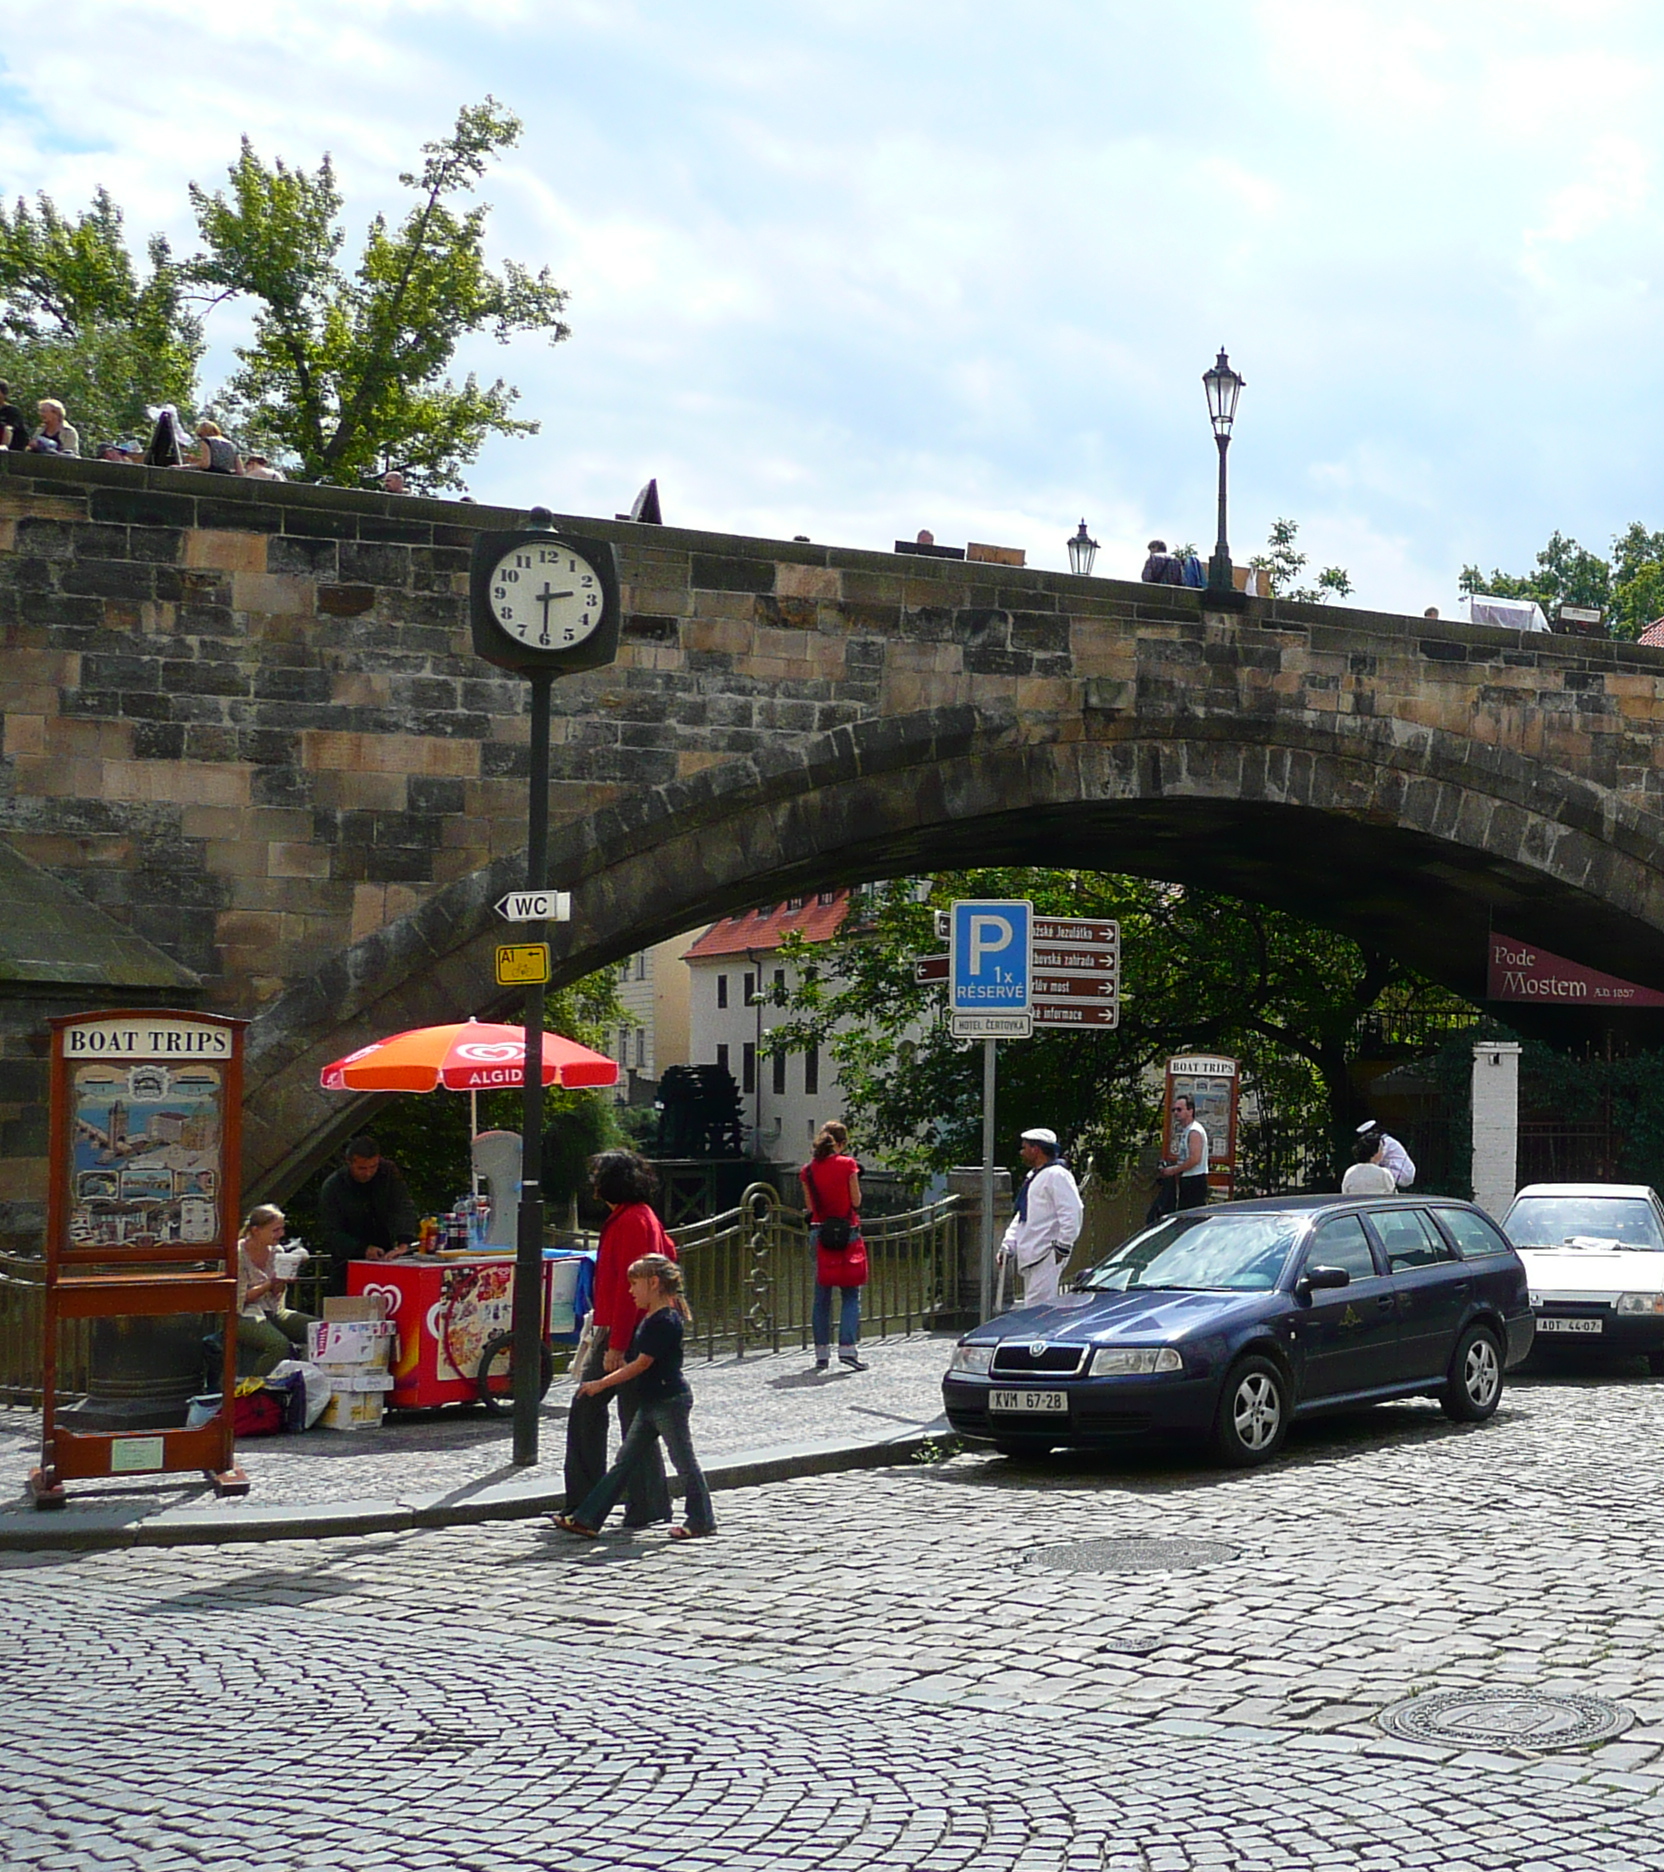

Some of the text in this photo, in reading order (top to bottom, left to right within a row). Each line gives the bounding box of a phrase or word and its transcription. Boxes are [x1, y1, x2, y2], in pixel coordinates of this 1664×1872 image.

[516, 555, 531, 569] 11
[540, 550, 559, 564] 12
[569, 559, 576, 572] 1
[500, 568, 520, 583] 10
[581, 575, 593, 588] 2
[494, 587, 506, 600] 9
[586, 594, 598, 607] 3
[501, 607, 513, 620] 8
[578, 613, 590, 626] 4
[516, 624, 528, 637] 7
[563, 628, 575, 641] 5
[539, 633, 551, 646] 6
[515, 897, 548, 916] WC
[969, 915, 1013, 975] P
[501, 950, 514, 963] A1
[1064, 953, 1095, 967] zahrada
[1493, 946, 1536, 967] Pode
[994, 966, 1014, 983] 1x
[957, 982, 1025, 998] RÉSERVÉ
[1050, 980, 1070, 993] most
[1500, 971, 1587, 997] Mostem
[1044, 1006, 1083, 1021] informace
[959, 1020, 983, 1031] HOTEL
[71, 1031, 226, 1052] BOAT TRIPS
[1173, 1062, 1234, 1074] BOAT TRIPS
[469, 1069, 525, 1084] ALGID
[1542, 1320, 1597, 1331] ADT 44-07
[1026, 1393, 1062, 1409] 67-28
